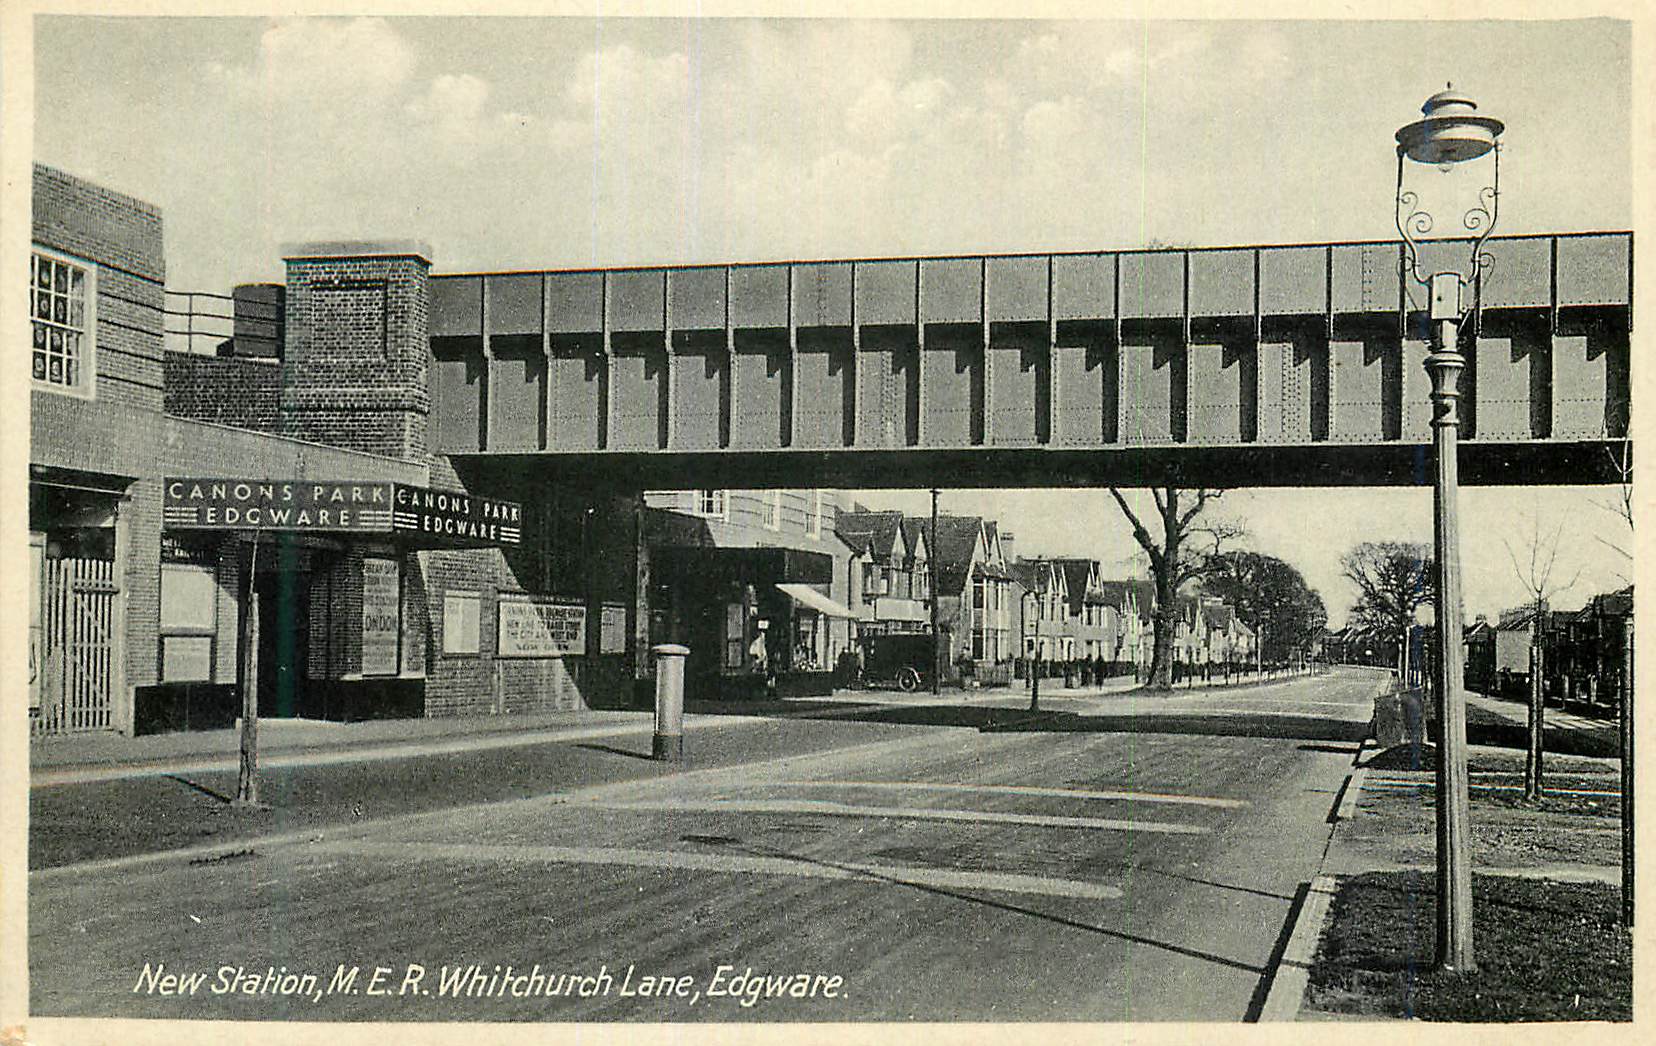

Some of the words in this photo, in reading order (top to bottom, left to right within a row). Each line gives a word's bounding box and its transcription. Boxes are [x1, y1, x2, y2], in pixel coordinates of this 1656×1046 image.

[169, 483, 293, 501] CANONS
[313, 486, 384, 503] PARK
[398, 489, 470, 514] CANONS
[484, 502, 519, 521] PARK
[206, 507, 350, 526] EDGWARE
[424, 515, 497, 540] EDGWARE
